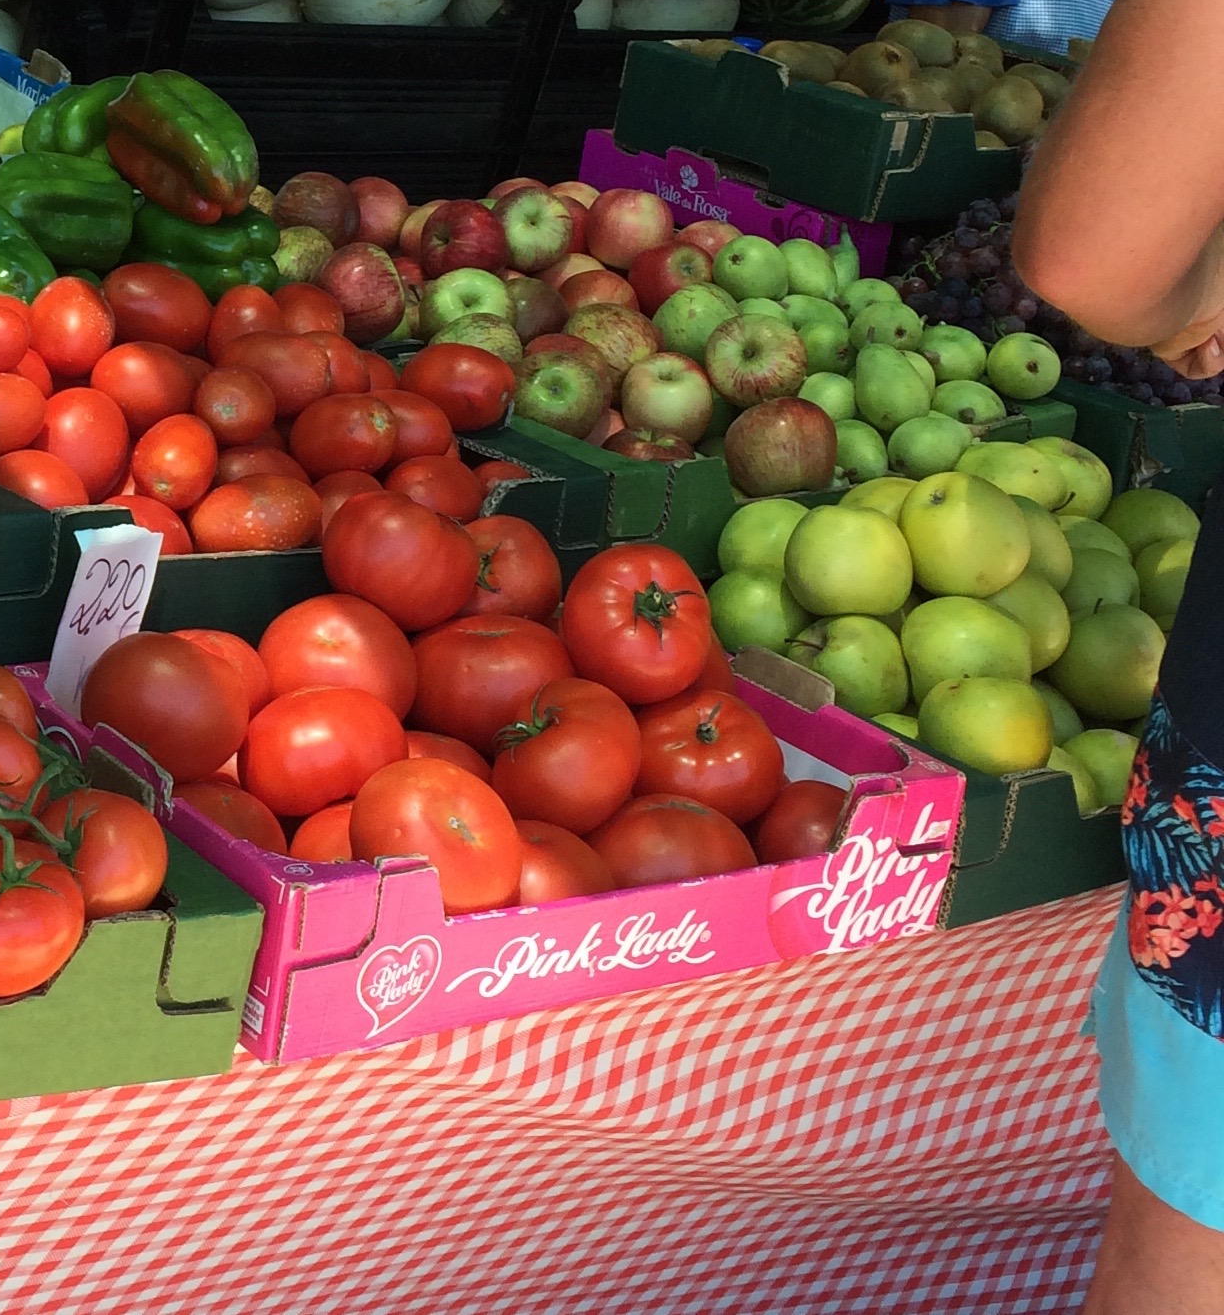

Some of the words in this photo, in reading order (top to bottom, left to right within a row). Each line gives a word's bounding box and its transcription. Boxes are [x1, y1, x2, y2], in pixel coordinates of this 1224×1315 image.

[654, 178, 681, 205] Vale
[681, 198, 692, 209] da
[693, 193, 728, 224] Rosa
[771, 801, 952, 919] Pink
[810, 867, 948, 955] Lady
[368, 948, 422, 998] Pink
[444, 921, 603, 999] Pink
[598, 909, 717, 971] Lady
[376, 970, 426, 1012] Lady
